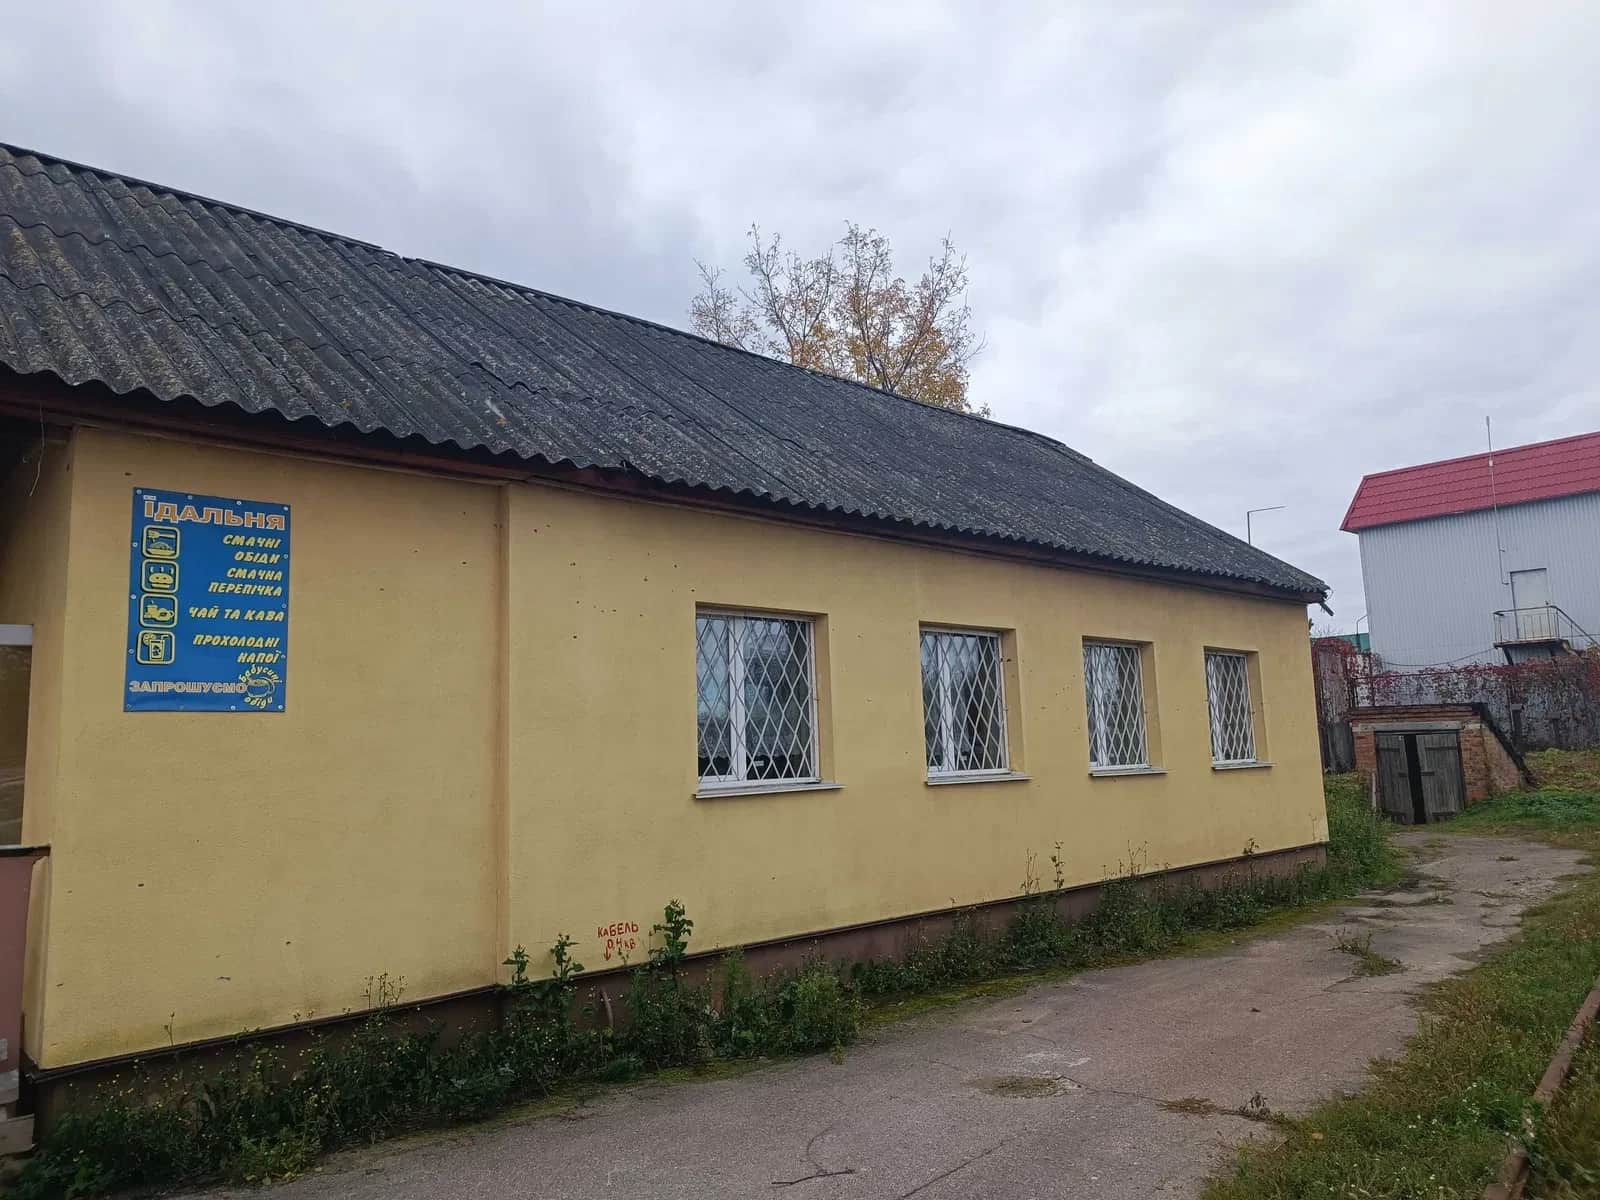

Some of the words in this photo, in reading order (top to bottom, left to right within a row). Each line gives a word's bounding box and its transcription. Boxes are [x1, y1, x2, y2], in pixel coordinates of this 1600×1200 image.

[143, 495, 285, 531] ЇДАЛЬНЯ
[222, 534, 281, 549] СМАЧНІ
[234, 551, 281, 564] ОБІДИ
[226, 567, 283, 582] СМАЧНА
[208, 583, 283, 597] ПЕРЕПІЧКА
[188, 605, 219, 619] ЧАЙ
[224, 608, 240, 620] ТА
[244, 608, 285, 623] КАВА
[192, 634, 280, 648] ПРОХОЛОДНІ
[236, 649, 281, 664] НАПОЇ
[597, 921, 639, 938] КАБЕЛЬ
